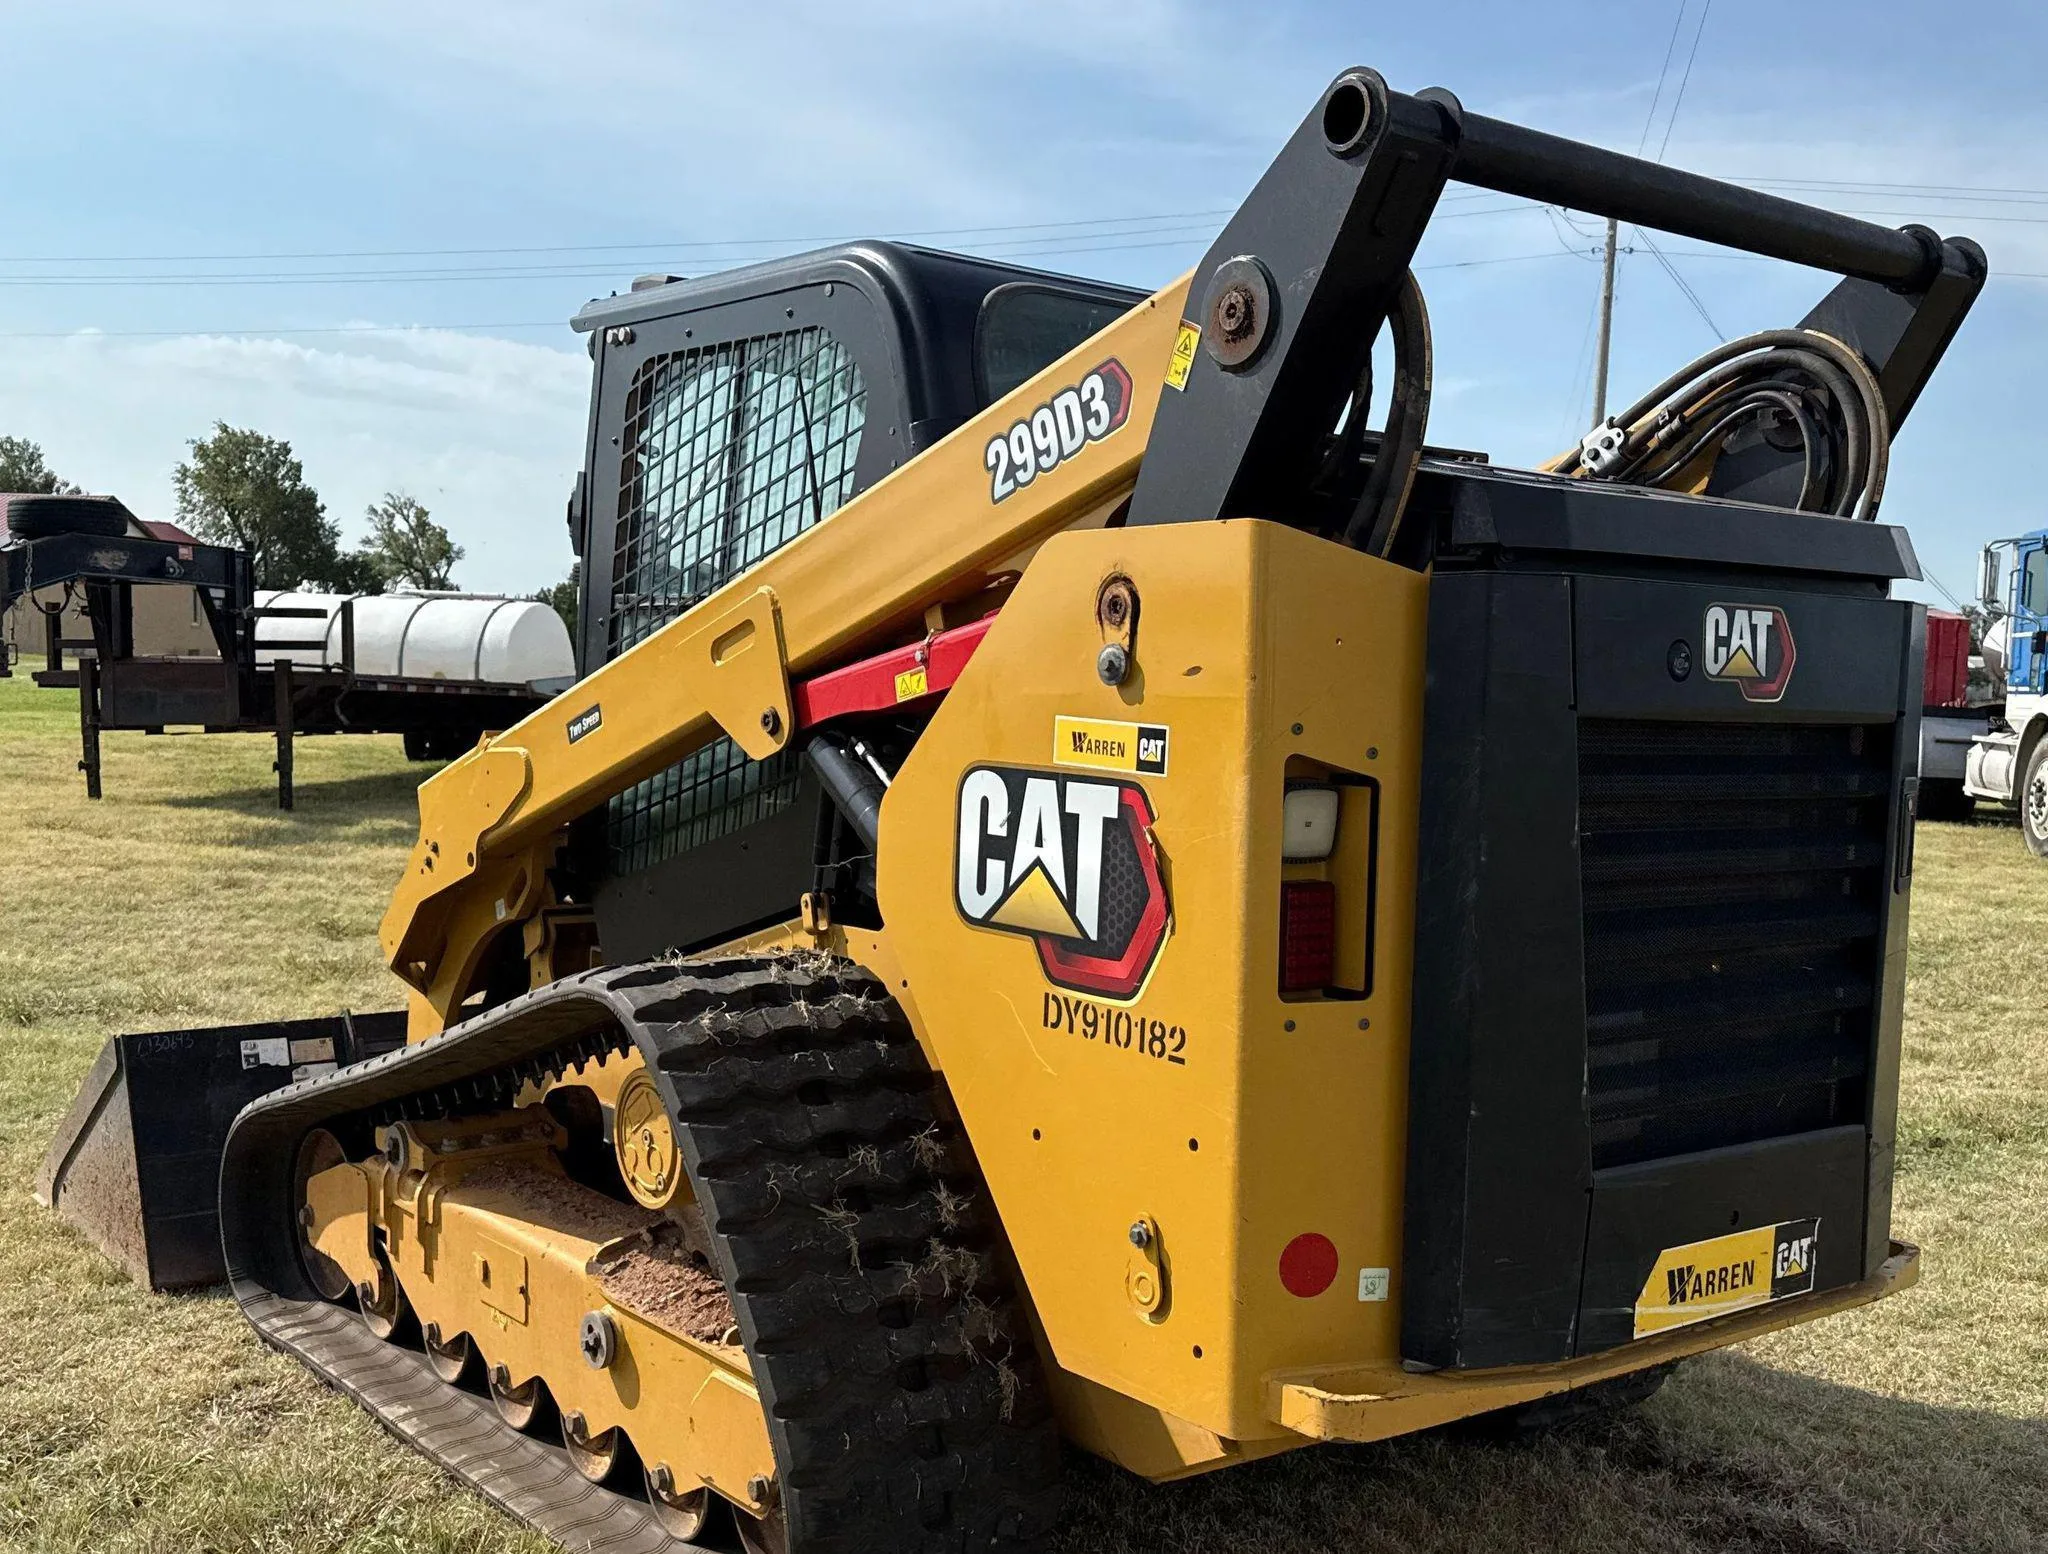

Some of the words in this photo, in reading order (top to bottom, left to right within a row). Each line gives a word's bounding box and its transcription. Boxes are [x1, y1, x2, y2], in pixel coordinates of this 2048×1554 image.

[986, 373, 1110, 500] 299D3
[1705, 606, 1773, 677] CAT
[1072, 731, 1125, 758] WARREN
[1139, 737, 1164, 762] CAT
[958, 769, 1119, 941] CAT
[1043, 992, 1186, 1065] DY910182
[1667, 1260, 1755, 1305] WARREN
[1774, 1237, 1811, 1279] CAT
